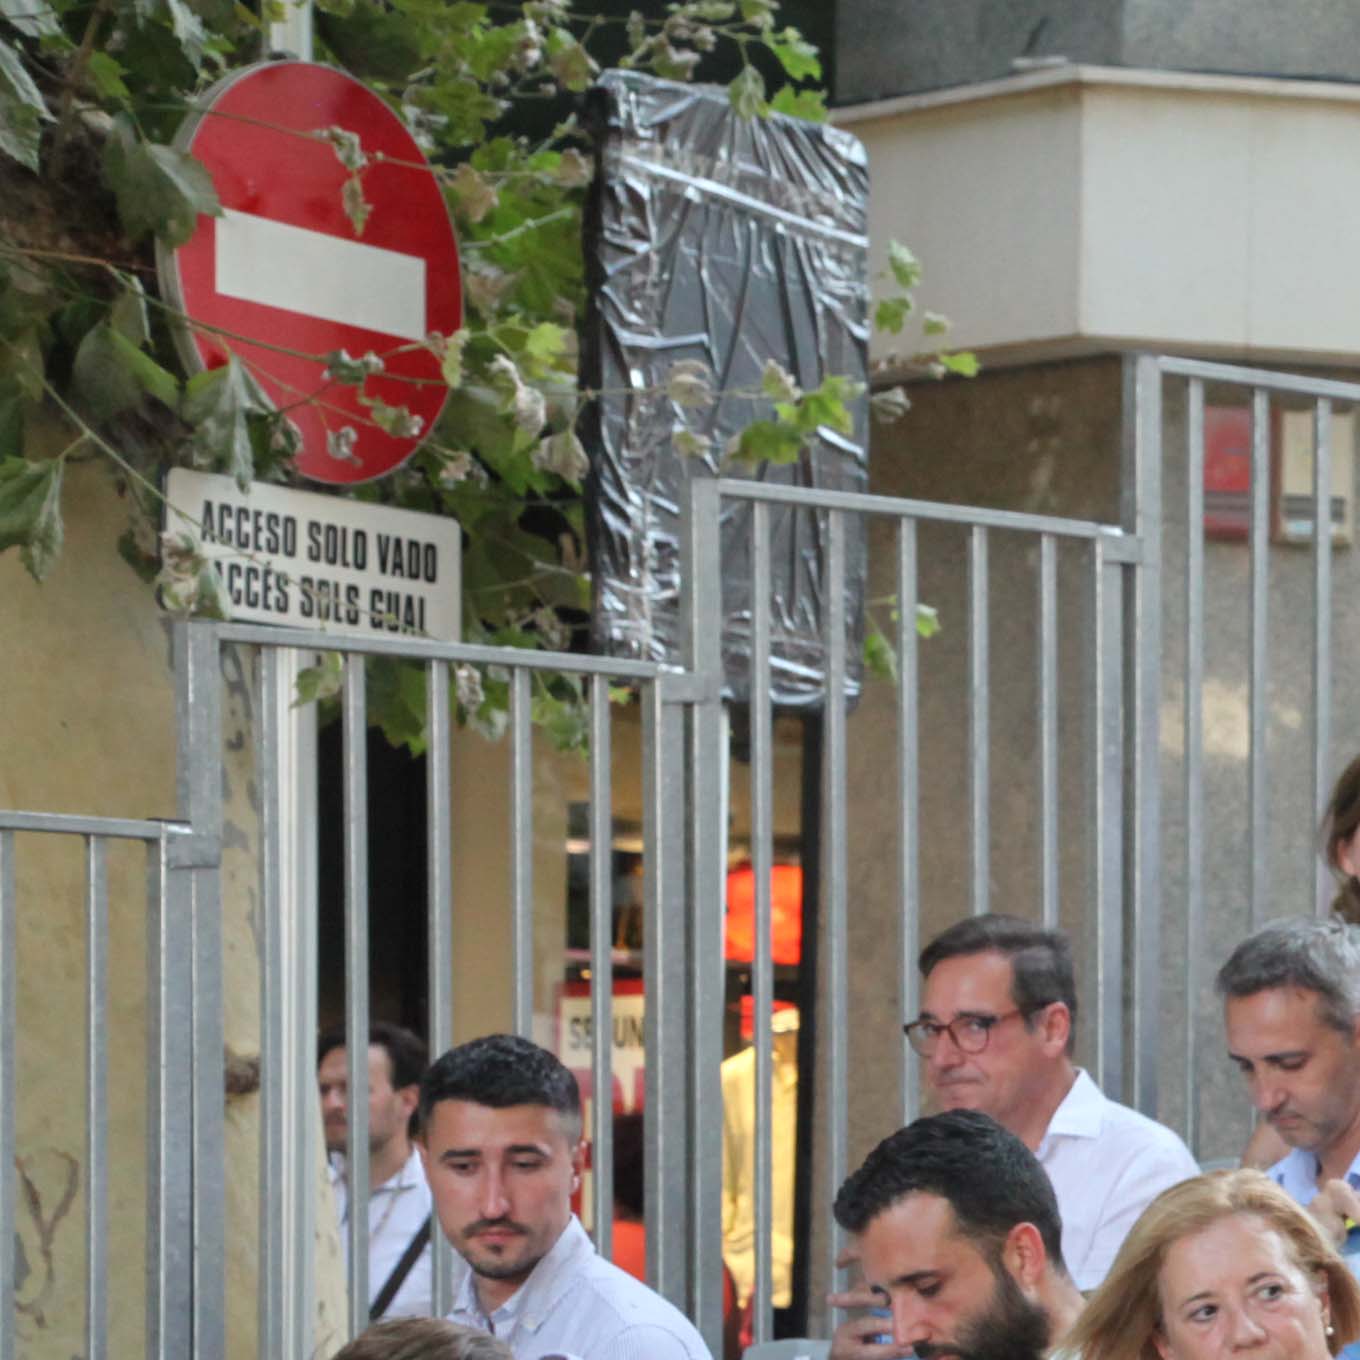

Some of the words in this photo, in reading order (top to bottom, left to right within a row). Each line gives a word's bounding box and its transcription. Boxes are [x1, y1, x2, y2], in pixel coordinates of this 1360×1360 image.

[201, 499, 297, 558] ACCESO
[307, 520, 367, 571] SOLO
[376, 532, 438, 584] VADO
[299, 576, 360, 626] SOLS
